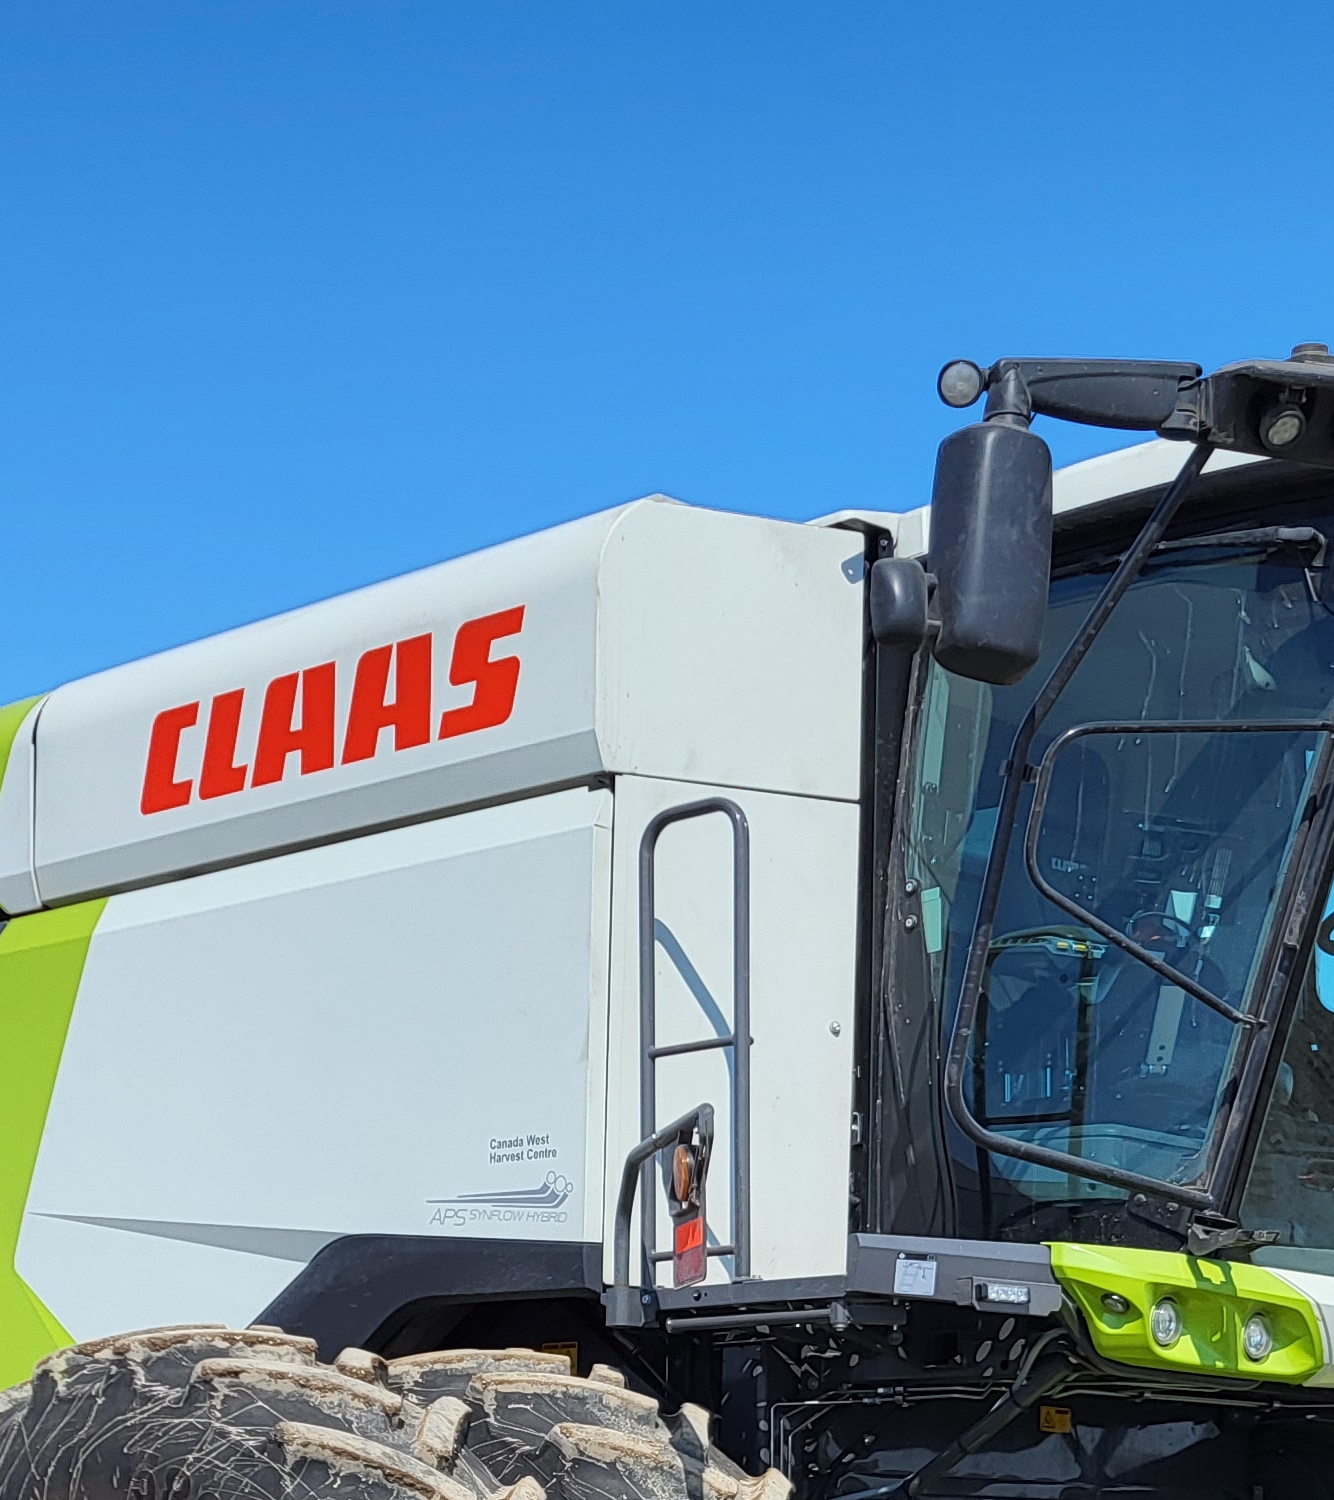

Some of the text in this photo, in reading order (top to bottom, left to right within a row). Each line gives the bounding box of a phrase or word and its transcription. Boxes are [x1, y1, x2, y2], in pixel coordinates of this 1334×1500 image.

[140, 603, 526, 816] CLAAS
[489, 1133, 550, 1150] Canada West
[489, 1148, 557, 1164] Harvest Centre
[429, 1208, 568, 1226] APS SYNFLOW HYBRID
